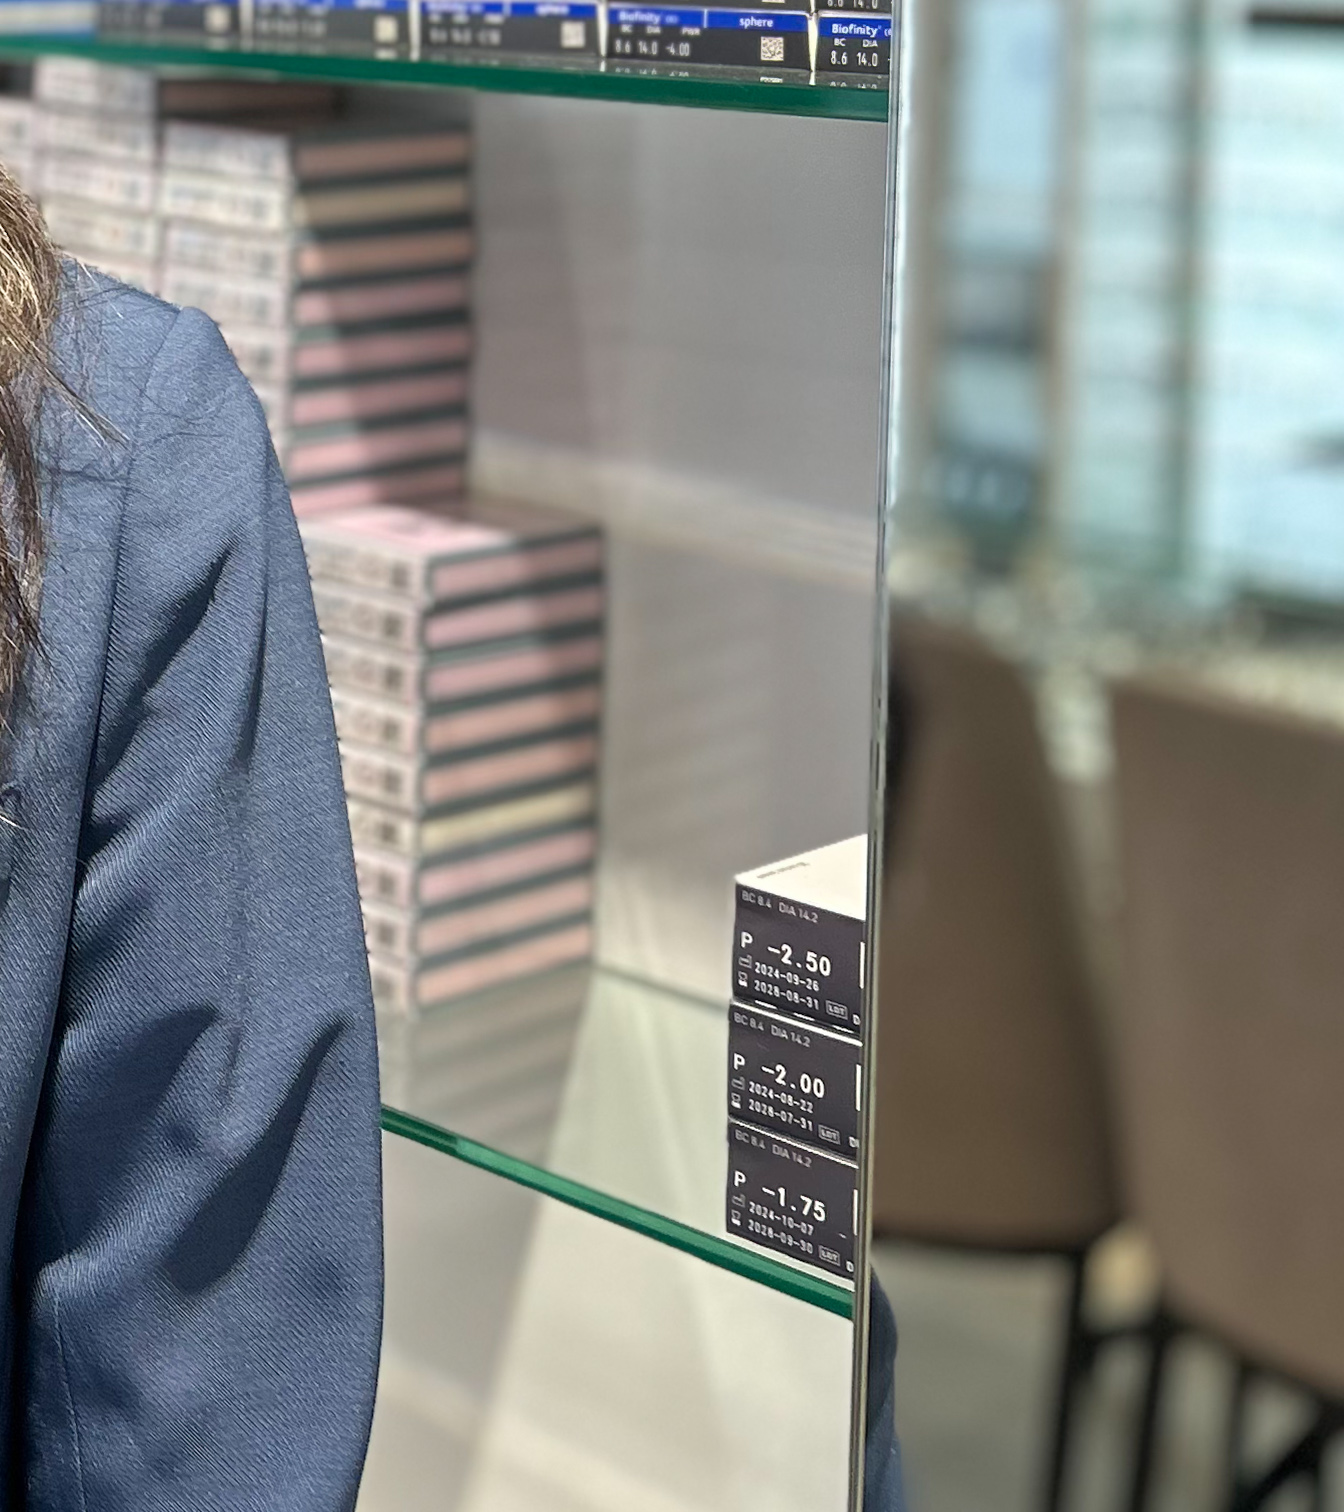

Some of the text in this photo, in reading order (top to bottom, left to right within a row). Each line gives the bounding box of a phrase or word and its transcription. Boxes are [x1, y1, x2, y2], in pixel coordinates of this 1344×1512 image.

[739, 17, 773, 28] sphere
[831, 24, 878, 36] Biofinity
[834, 38, 877, 47] BC DIA
[742, 891, 755, 901] BC
[779, 902, 796, 916] DIA
[799, 908, 818, 923] 14.2
[741, 932, 831, 976] P -2.50
[755, 962, 820, 991] 2024-09-26
[734, 1012, 748, 1024] BC
[771, 1026, 788, 1039] DIA
[791, 1032, 810, 1047] 14.2
[733, 1053, 824, 1098] P -2.00
[736, 1130, 749, 1143] BC
[772, 1145, 790, 1159] DIA
[793, 1152, 812, 1167] 14.2
[734, 1171, 826, 1221] P -1.75
[750, 1202, 814, 1235] 2024-10-07
